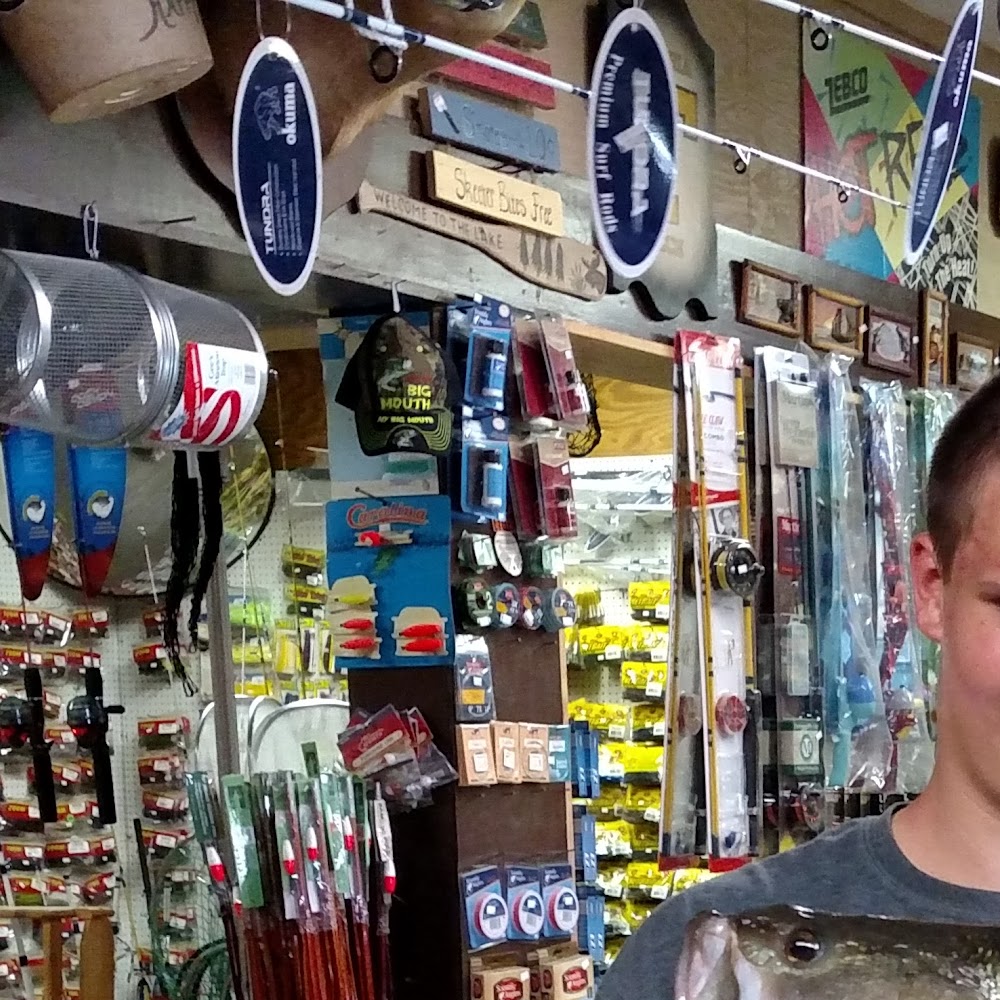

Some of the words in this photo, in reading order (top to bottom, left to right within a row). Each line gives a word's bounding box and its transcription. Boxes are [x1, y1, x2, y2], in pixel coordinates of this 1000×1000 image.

[595, 53, 625, 129] Premium
[825, 66, 870, 112] ZEBCO
[953, 39, 974, 108] okuma
[279, 82, 298, 146] okuma
[630, 68, 653, 218] TUDRA
[594, 141, 612, 181] Surf
[260, 180, 274, 256] TUNDRA
[374, 189, 428, 221] WELCOME
[432, 211, 447, 228] TO
[450, 217, 470, 238] THE
[473, 226, 504, 250] LAKE
[453, 167, 495, 209] Skeeter
[531, 191, 553, 227] Free
[597, 192, 620, 234] Rods
[379, 397, 432, 411] MOUTH
[407, 383, 432, 398] BIG
